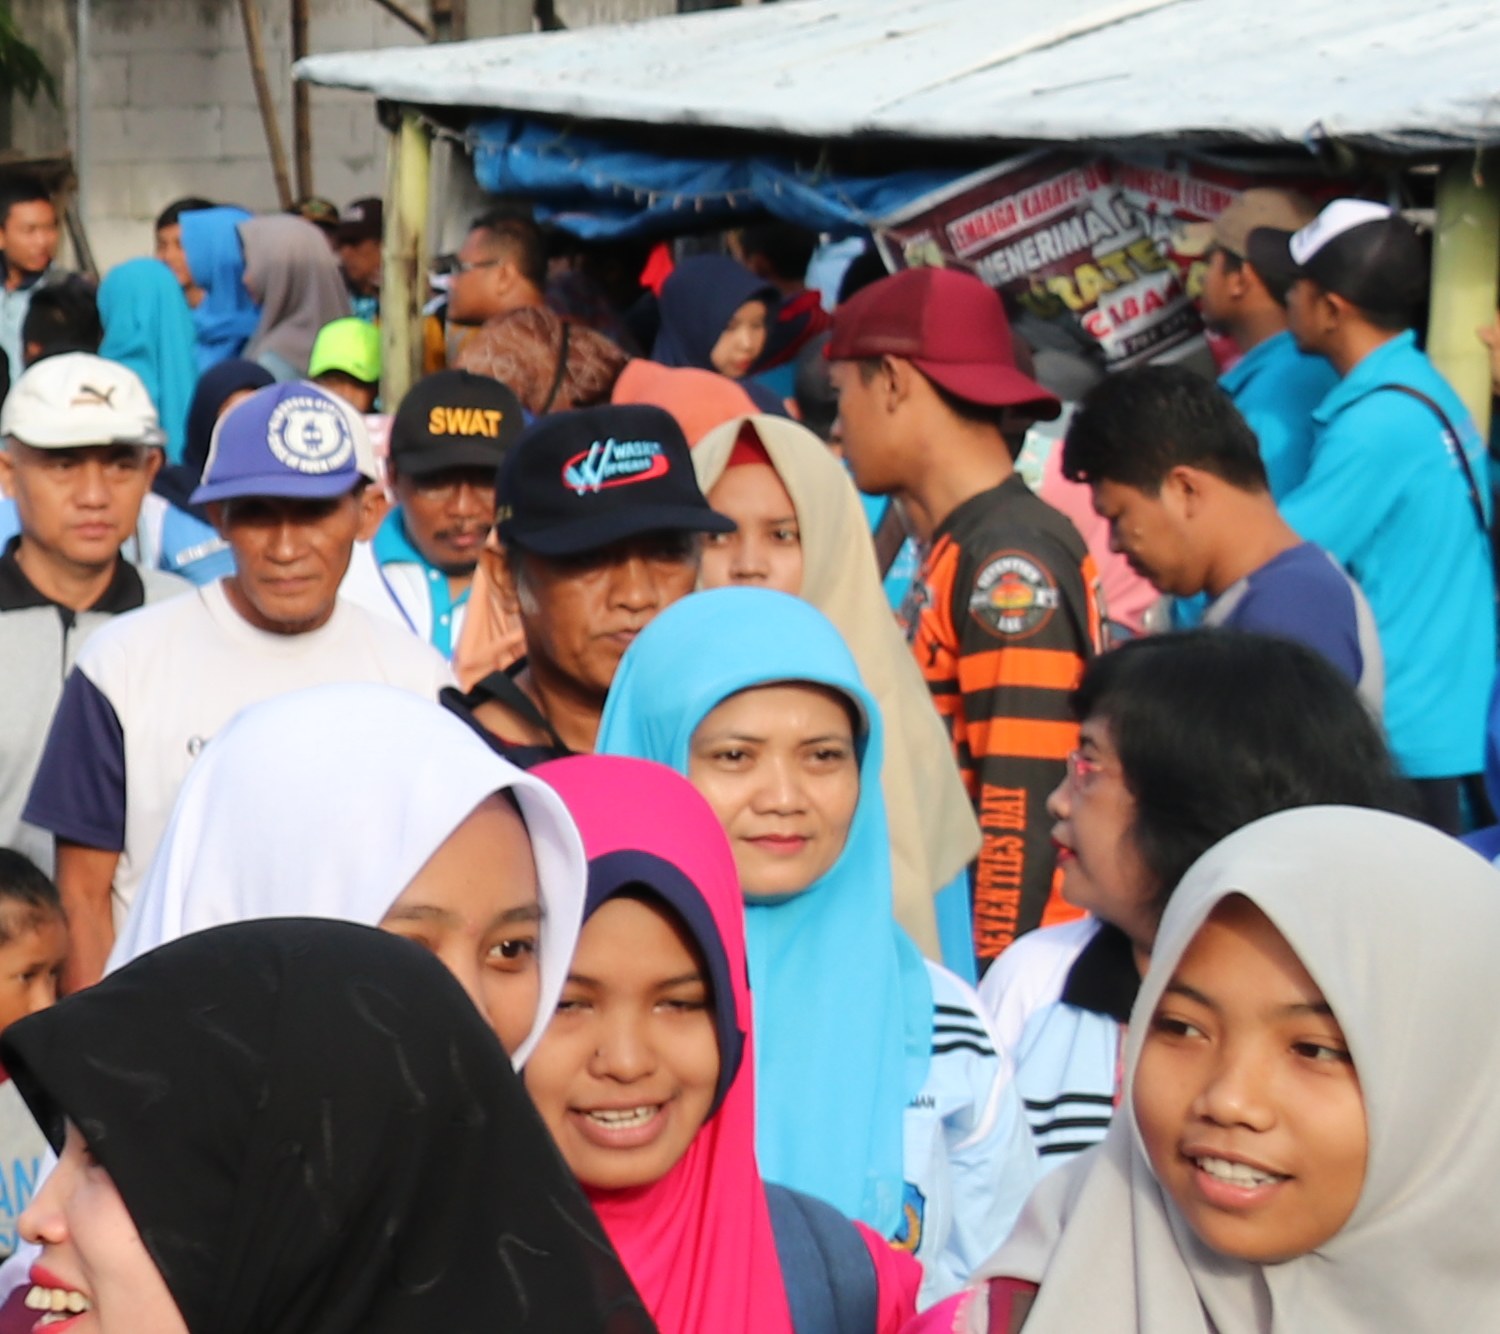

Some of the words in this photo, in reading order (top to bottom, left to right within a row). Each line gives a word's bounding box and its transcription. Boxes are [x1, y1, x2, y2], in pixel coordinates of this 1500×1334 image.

[428, 404, 504, 438] SWAT
[979, 783, 1028, 831] DAY
[973, 832, 1026, 959] SEVENTIES
